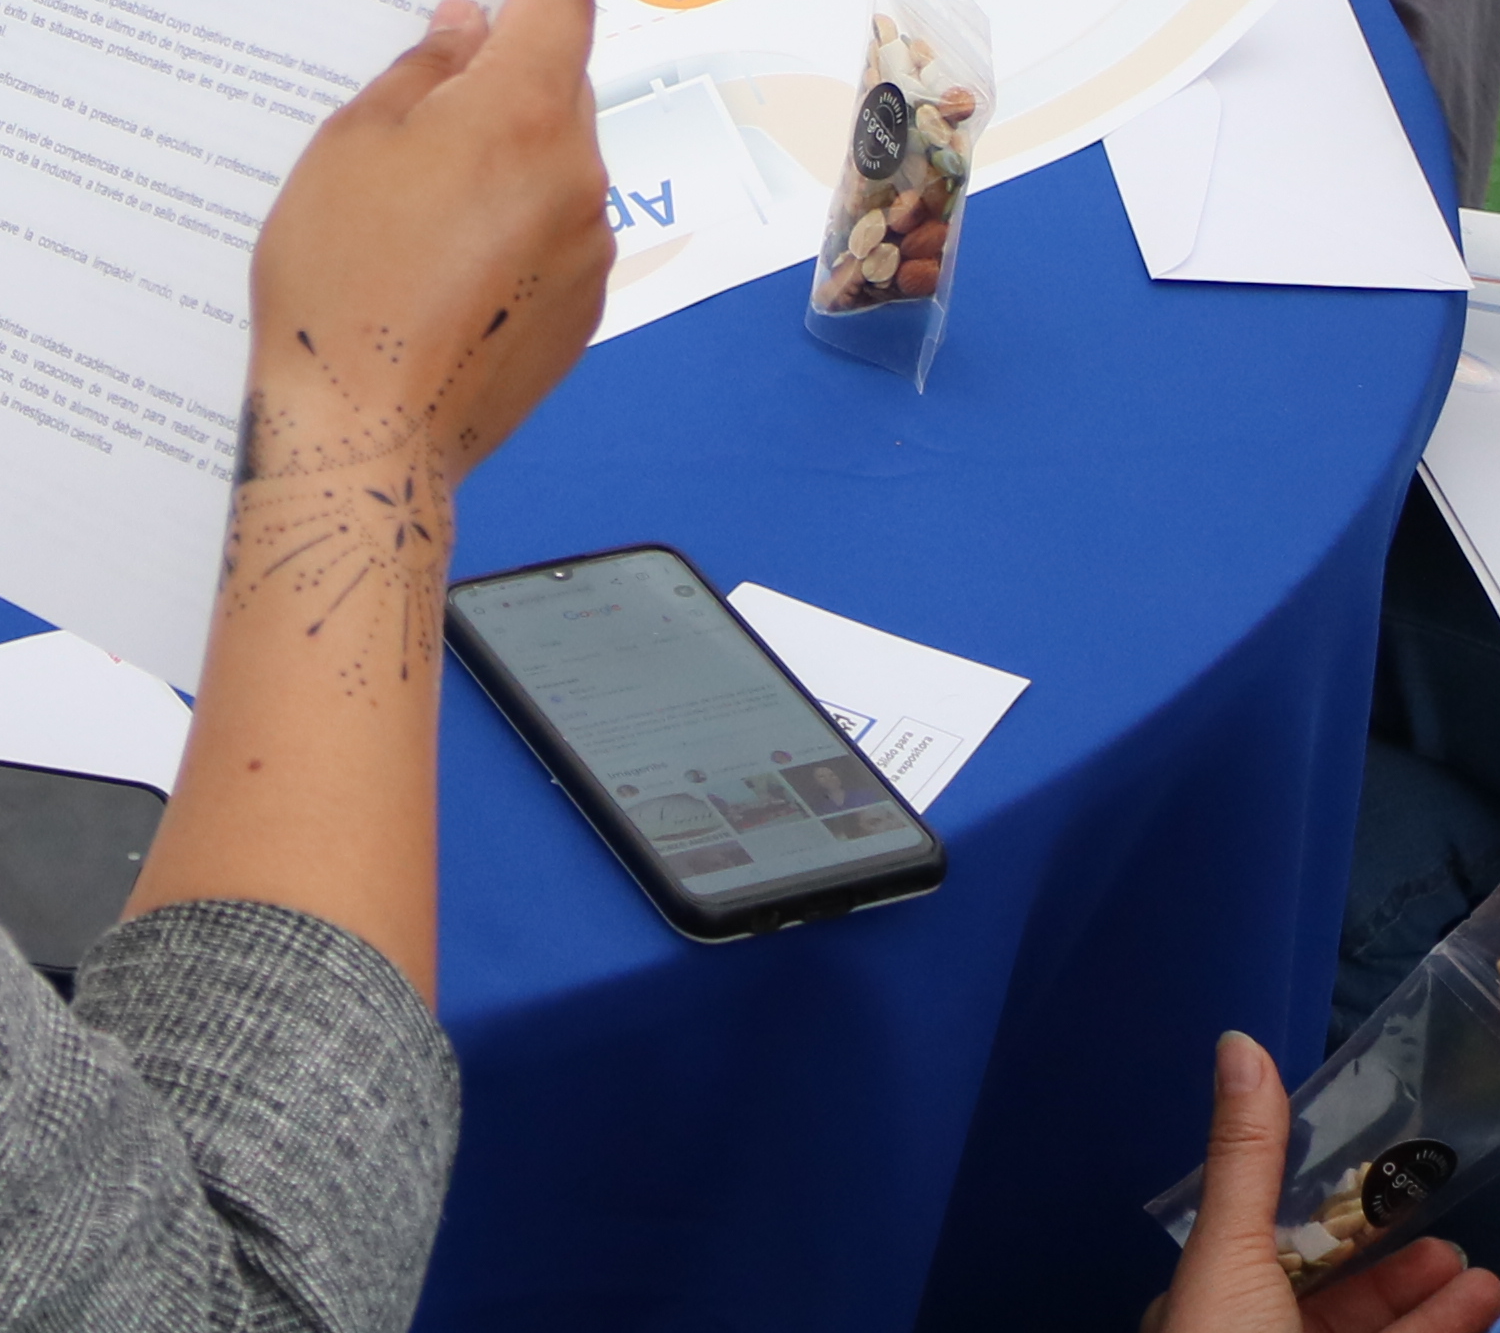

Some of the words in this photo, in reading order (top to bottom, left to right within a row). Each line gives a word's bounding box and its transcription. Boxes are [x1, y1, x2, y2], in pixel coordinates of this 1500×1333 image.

[4, 122, 17, 134] el
[15, 127, 41, 143] nivel
[38, 135, 54, 149] de
[52, 142, 120, 176] competencias
[60, 95, 76, 110] de
[76, 100, 88, 115] la
[88, 107, 138, 134] presencia
[139, 125, 154, 139] de
[155, 133, 204, 158] ejecutivos
[204, 151, 214, 163] y
[213, 154, 280, 186] profesionales
[867, 117, 901, 160] granel
[606, 178, 677, 234] Ap
[29, 333, 73, 358] unidades
[9, 397, 70, 434] investigación
[563, 603, 623, 620] Google
[877, 749, 898, 768] Slido
[895, 731, 914, 750] para
[896, 736, 934, 774] expositora
